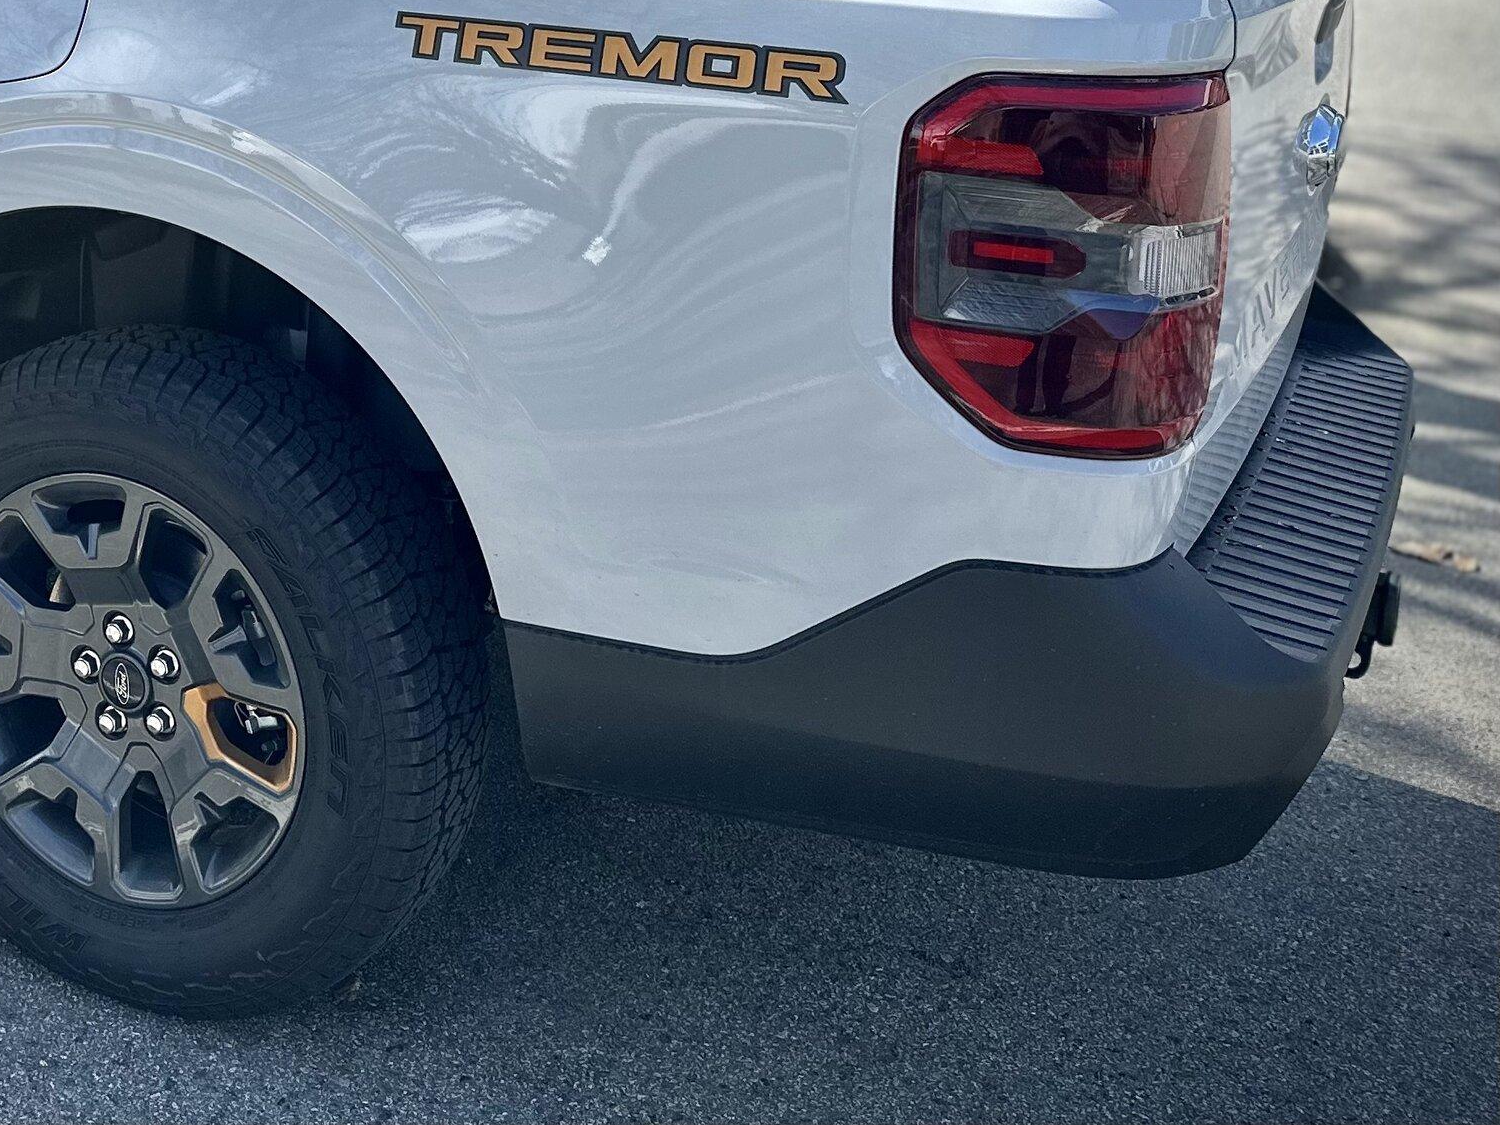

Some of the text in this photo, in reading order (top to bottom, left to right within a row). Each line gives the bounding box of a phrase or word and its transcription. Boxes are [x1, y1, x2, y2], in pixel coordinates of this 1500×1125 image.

[396, 11, 849, 104] TREMOR
[115, 669, 128, 700] Ford
[247, 526, 351, 820] FALKEN
